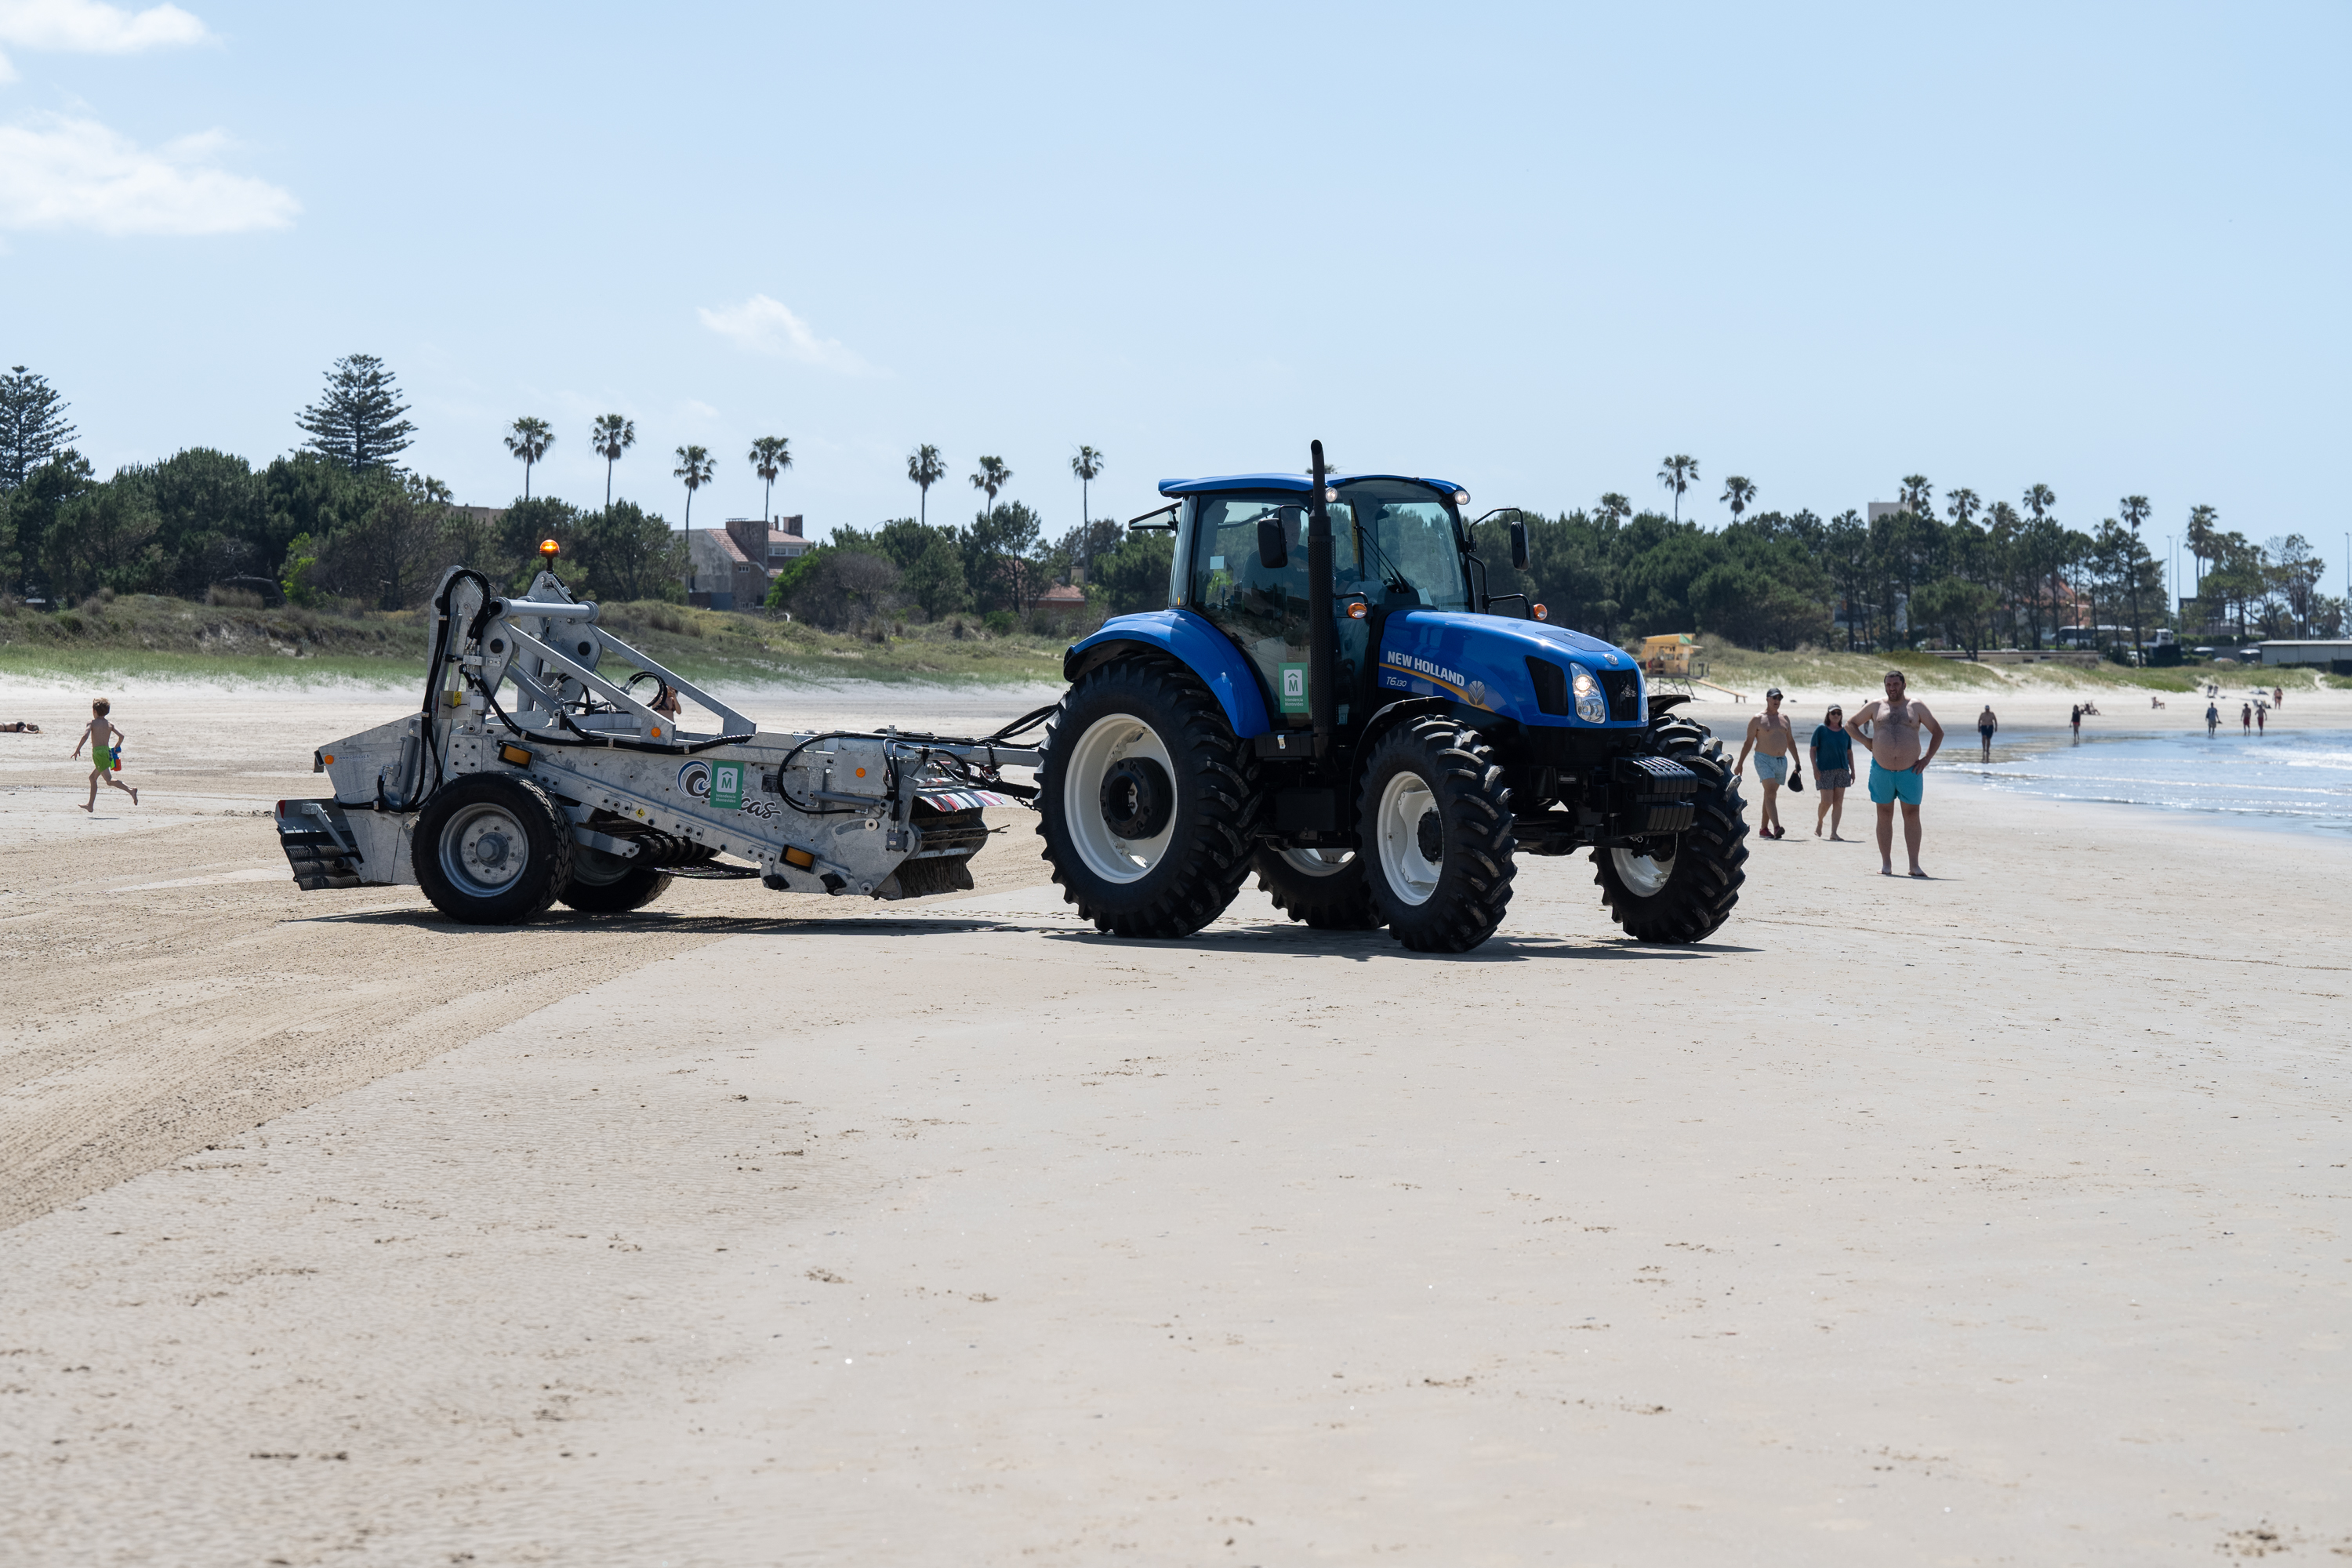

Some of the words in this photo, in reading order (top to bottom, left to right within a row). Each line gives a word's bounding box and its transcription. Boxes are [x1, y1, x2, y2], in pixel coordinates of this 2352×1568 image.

[1387, 651, 1412, 668] NEW
[1414, 658, 1465, 687] HOLLAND
[1288, 679, 1298, 691] M
[1386, 677, 1407, 687] T6.130
[721, 777, 732, 789] M
[677, 760, 782, 820] Ccas
